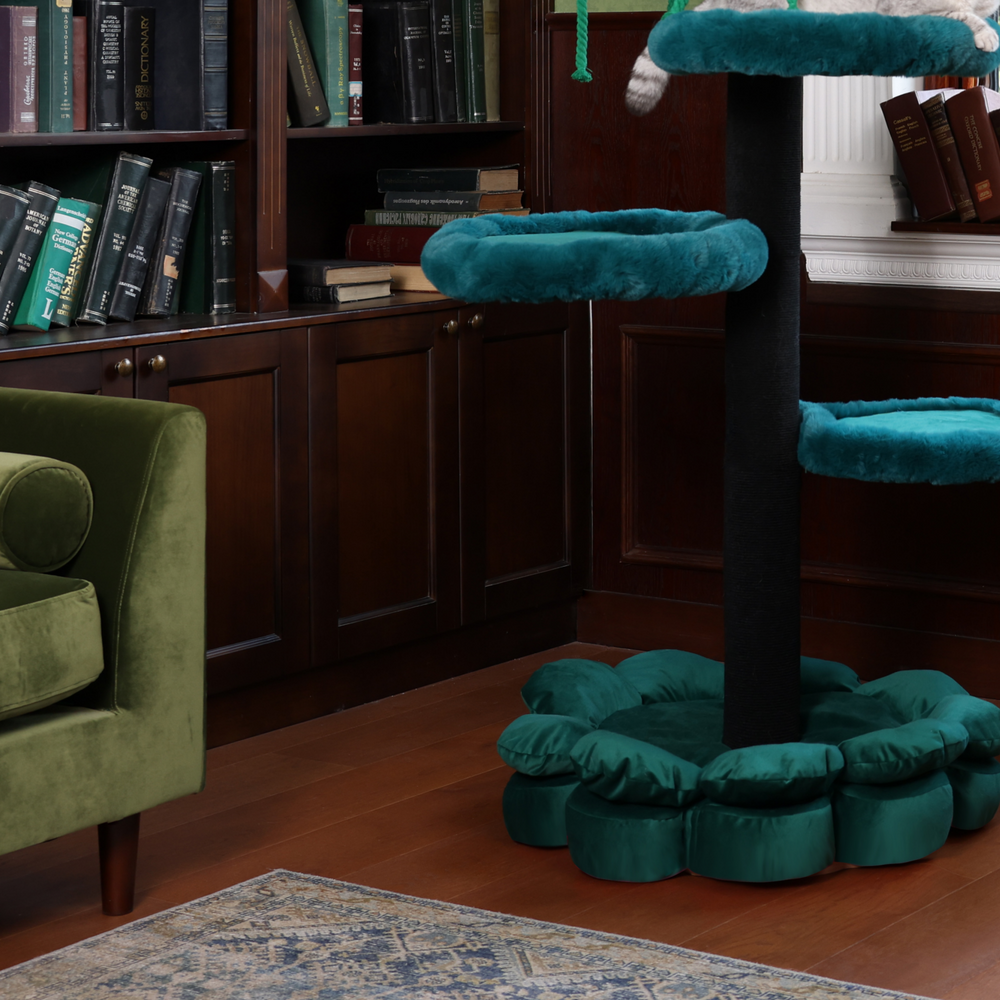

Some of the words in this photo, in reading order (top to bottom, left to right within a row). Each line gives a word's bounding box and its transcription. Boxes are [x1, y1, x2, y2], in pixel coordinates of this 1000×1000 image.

[140, 16, 149, 83] DICTIONARY
[973, 126, 983, 149] CONCISE
[964, 116, 972, 137] OXFORD
[968, 137, 982, 171] DICTIONARY
[121, 184, 141, 194] JOURNAL
[117, 200, 137, 209] CHEMICAL
[118, 194, 139, 204] AMERICAN
[118, 205, 135, 214] SOCIETY
[26, 210, 49, 221] AMERICAN
[26, 216, 47, 227] JOURNAL
[24, 225, 43, 236] BOTANY
[52, 234, 77, 248] German
[72, 222, 93, 298] ADVANCED
[41, 298, 54, 320] L
